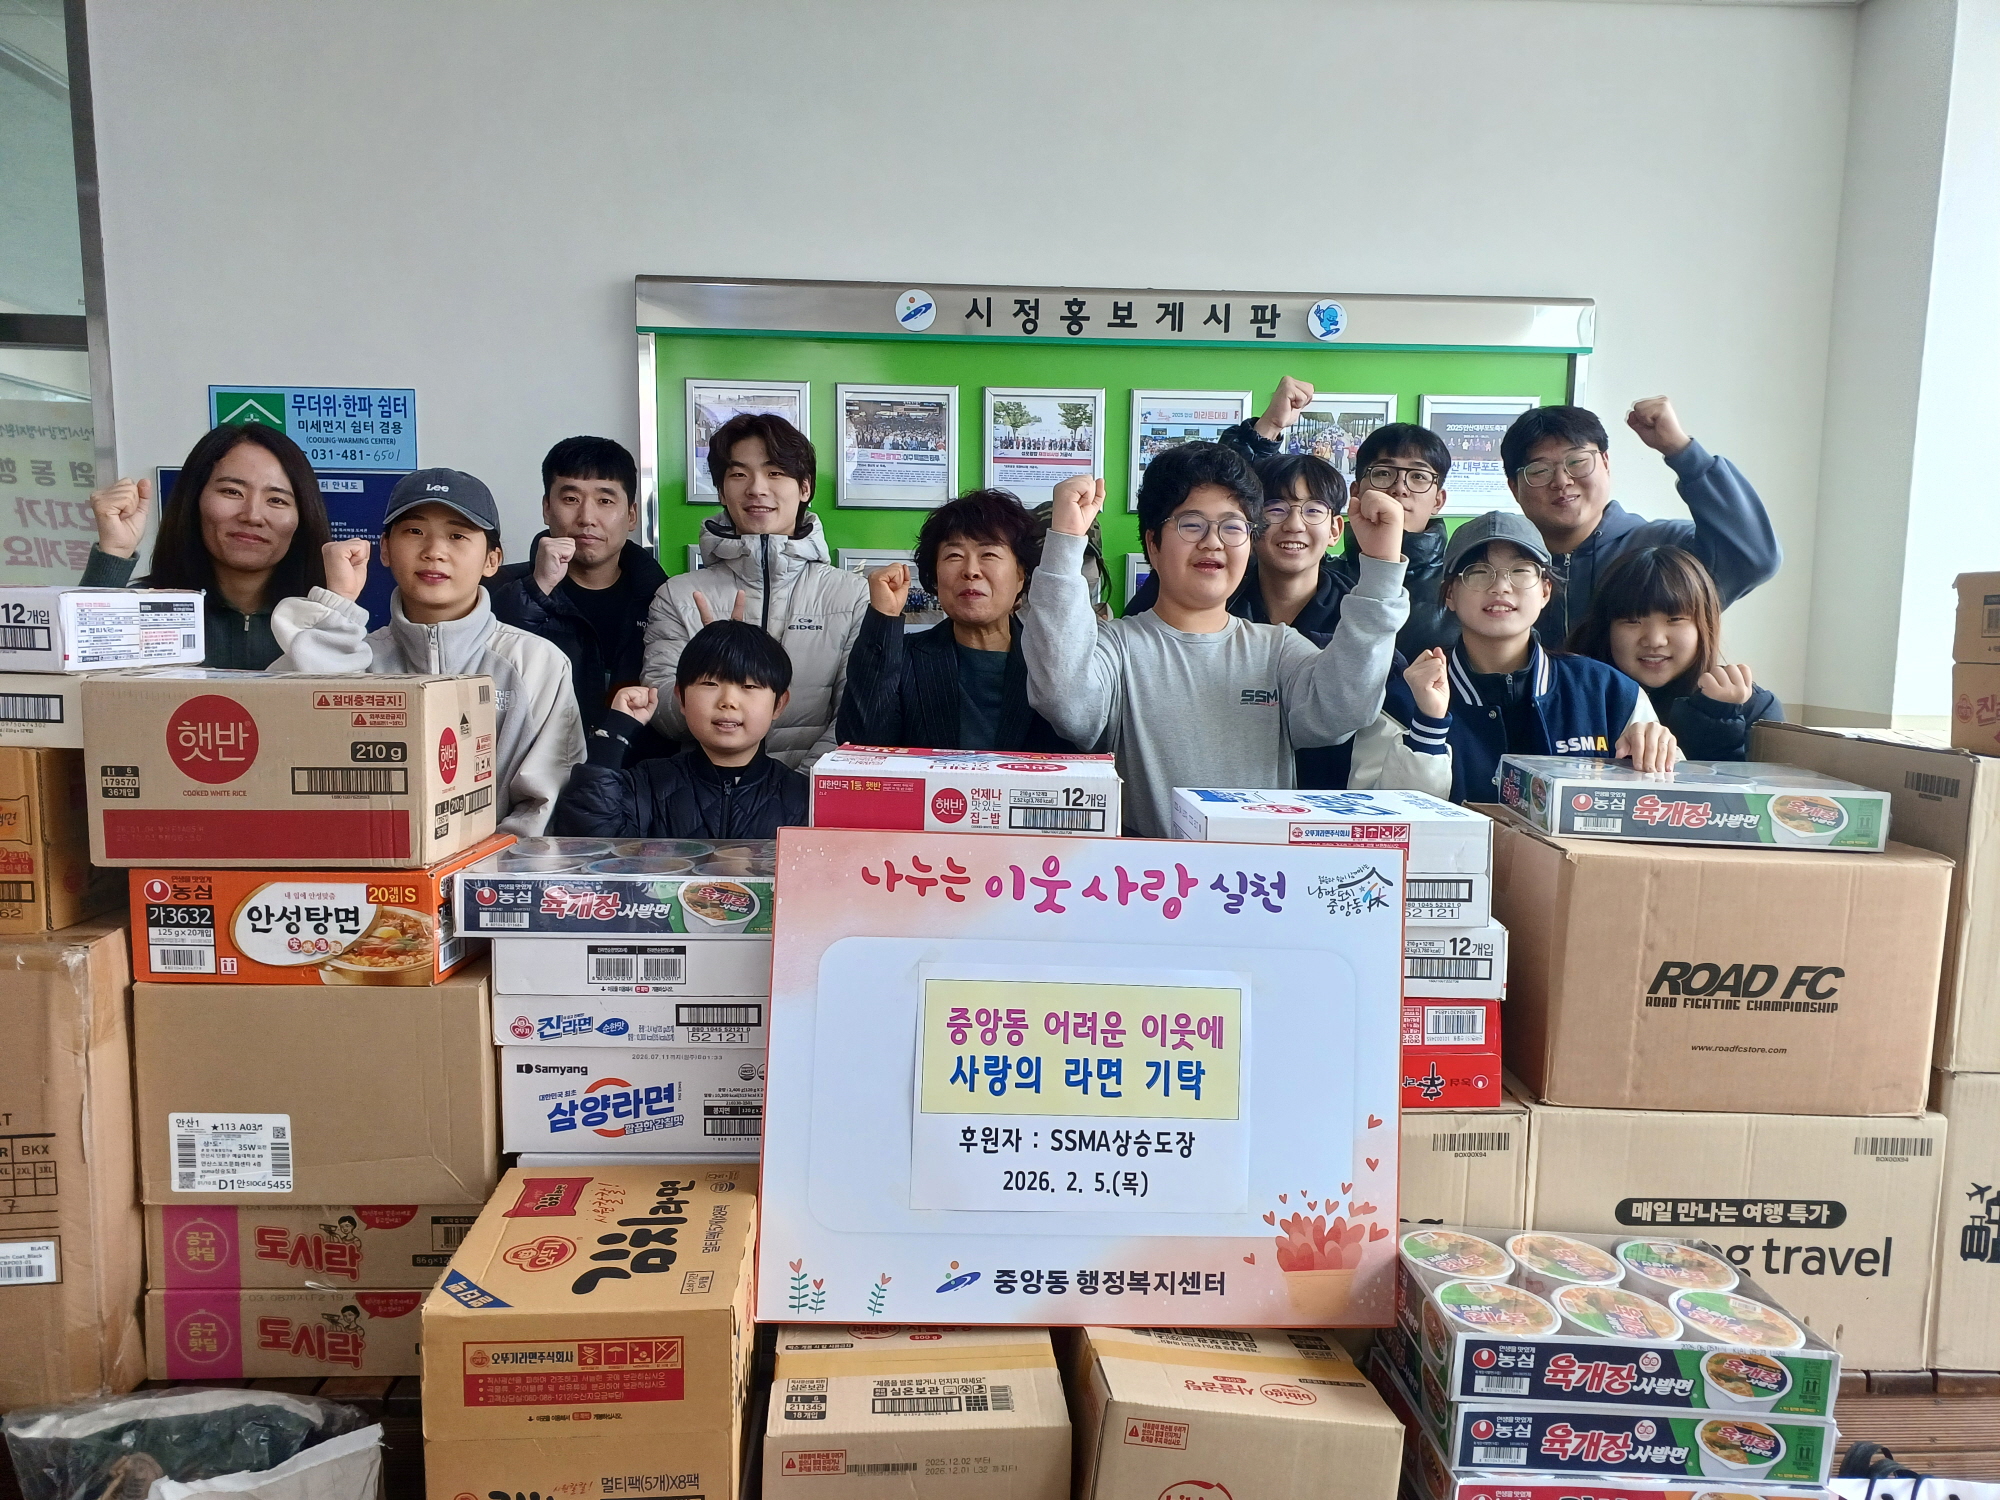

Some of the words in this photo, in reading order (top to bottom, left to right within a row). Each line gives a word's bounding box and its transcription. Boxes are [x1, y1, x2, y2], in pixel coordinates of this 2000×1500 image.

[965, 297, 1281, 338] 시정홍보게시판
[378, 395, 407, 418] 쉼터
[298, 420, 346, 433] 미세먼지
[350, 421, 374, 434] 쉼터
[379, 422, 403, 434] 겸용
[332, 481, 358, 490] 안내도
[426, 483, 450, 493] Lee
[1, 602, 50, 624] 12개입
[333, 695, 402, 706] 절대충격금지!
[1241, 689, 1279, 704] SSM
[178, 721, 249, 761] 햇반
[1556, 736, 1608, 753] SSMA
[356, 745, 386, 759] 210
[390, 748, 402, 761] g
[441, 744, 456, 771] 햇반
[108, 788, 135, 797] 36개입
[819, 780, 849, 790] 대한민국
[866, 781, 881, 791] 햇반
[971, 788, 1002, 801] 언제나
[1062, 788, 1107, 808] 12개입
[936, 798, 964, 815] 햇반
[972, 802, 1001, 812] 맛있는
[1594, 797, 1625, 811] 농심
[1632, 794, 1712, 829] 육개장
[1708, 813, 1761, 829] 사발면
[1787, 801, 1839, 821] 육개장
[172, 884, 213, 901] 농심
[405, 888, 417, 903] S
[862, 856, 971, 902] 나누는
[984, 854, 1071, 914] 이웃
[1082, 863, 1198, 920] 사랑
[1210, 870, 1287, 914] 실천
[308, 892, 336, 900] 안성맞춤
[499, 891, 532, 904] 농심
[540, 886, 621, 920] 육개장
[618, 903, 671, 919] 사발면
[698, 888, 750, 907] 육개장
[150, 907, 212, 925] 가3632
[1327, 898, 1363, 917] 중앙동
[1428, 909, 1454, 918] 121
[248, 905, 361, 935] 안성탕면
[1450, 938, 1493, 957] 12개입
[1647, 961, 1779, 998] ROAD
[1780, 966, 1845, 1001] FC
[1646, 996, 1677, 1008] ROAD
[1683, 998, 1740, 1011] FIGHTING
[1746, 1000, 1838, 1014] CHAMPIONSHIP
[537, 1015, 593, 1041] 진라면
[603, 1021, 625, 1034] 순한맛
[946, 1007, 1029, 1047] 중앙동
[1044, 1010, 1127, 1049] 어려운
[1142, 1014, 1225, 1051] 이웃에
[691, 1033, 711, 1042] 52
[718, 1033, 744, 1042] 121
[1692, 1045, 1787, 1054] www.roadfcstore.com
[535, 1064, 588, 1075] Samyang
[950, 1055, 1043, 1095] 사랑의
[1065, 1058, 1124, 1098] 라면
[1146, 1060, 1206, 1100] 기탁
[1403, 1062, 1446, 1101] 辛라
[1450, 1078, 1471, 1087] 농심
[539, 1092, 563, 1101] 대한민국
[547, 1083, 675, 1134] 삼양라면
[176, 1117, 200, 1128] 안산1
[624, 1120, 654, 1135] 깔끔한
[654, 1115, 684, 1130] 감칠맛
[959, 1126, 1023, 1155] 후원자
[1050, 1128, 1196, 1157] SSMA상승도장
[21, 1145, 49, 1156] BKX
[219, 1180, 235, 1190] D1
[268, 1181, 292, 1190] 5455
[1002, 1172, 1056, 1193] 2026.
[1066, 1173, 1084, 1193] 2.
[1094, 1172, 1150, 1199] 5.(목)
[1632, 1202, 1673, 1222] 매일
[1677, 1202, 1739, 1223] 만나는
[1743, 1203, 1783, 1224] 여행
[1787, 1204, 1831, 1224] 특가
[186, 1232, 216, 1245] 공구
[572, 1180, 696, 1295] 김치라면
[187, 1247, 216, 1261] 핫딜
[254, 1225, 363, 1282] 도시락
[536, 1242, 561, 1265] 오뚜기
[1762, 1237, 1892, 1277] travel
[994, 1271, 1069, 1296] 중앙동
[1078, 1270, 1226, 1297] 행정복지센터
[189, 1323, 217, 1336] 공구
[189, 1338, 217, 1352] 핫딜
[257, 1316, 366, 1371] 도시락
[492, 1351, 574, 1365] 오뚜기라면주식회사
[1498, 1353, 1535, 1369] 농심
[1544, 1353, 1637, 1395] 육개장
[1633, 1377, 1695, 1397] 사발면
[1723, 1359, 1782, 1384] 육개장
[890, 1386, 940, 1396] 실온보관
[1184, 1380, 1255, 1396] 사골곰탕
[1264, 1388, 1312, 1401] bibigo
[789, 1403, 823, 1411] 211345
[1495, 1424, 1532, 1439] 농심
[1717, 1427, 1776, 1451] 육개장
[1541, 1423, 1633, 1464] 육개장
[1628, 1446, 1690, 1465] 사발면
[926, 1458, 971, 1466] 2025.12.02
[974, 1457, 991, 1465] 부터
[926, 1466, 970, 1475] 2026.12.01
[973, 1466, 988, 1474] L32
